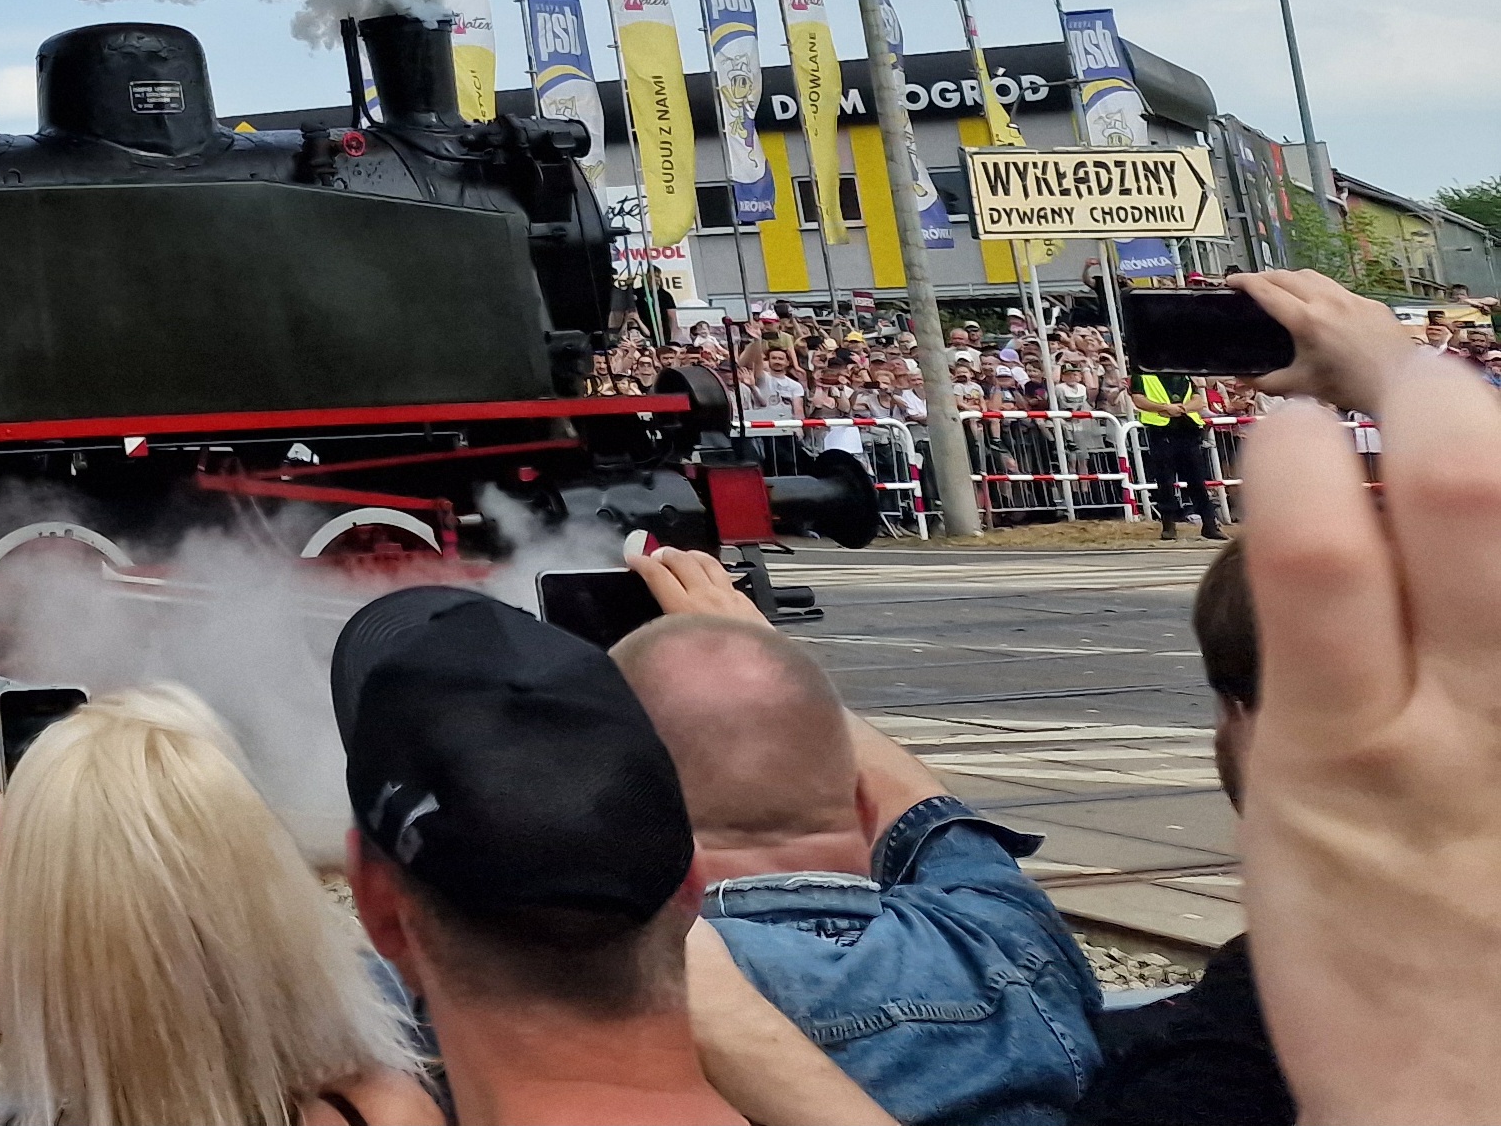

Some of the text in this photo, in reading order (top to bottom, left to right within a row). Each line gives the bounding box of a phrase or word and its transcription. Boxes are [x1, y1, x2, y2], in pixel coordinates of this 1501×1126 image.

[536, 6, 582, 61] psb
[1069, 20, 1120, 80] psb
[770, 65, 1050, 121] DM OGRÓD
[651, 75, 676, 195] BUDUJ Z NAMI
[981, 160, 1177, 200] WYKŁADZINY
[988, 204, 1186, 227] DYWANY CHODNIKI
